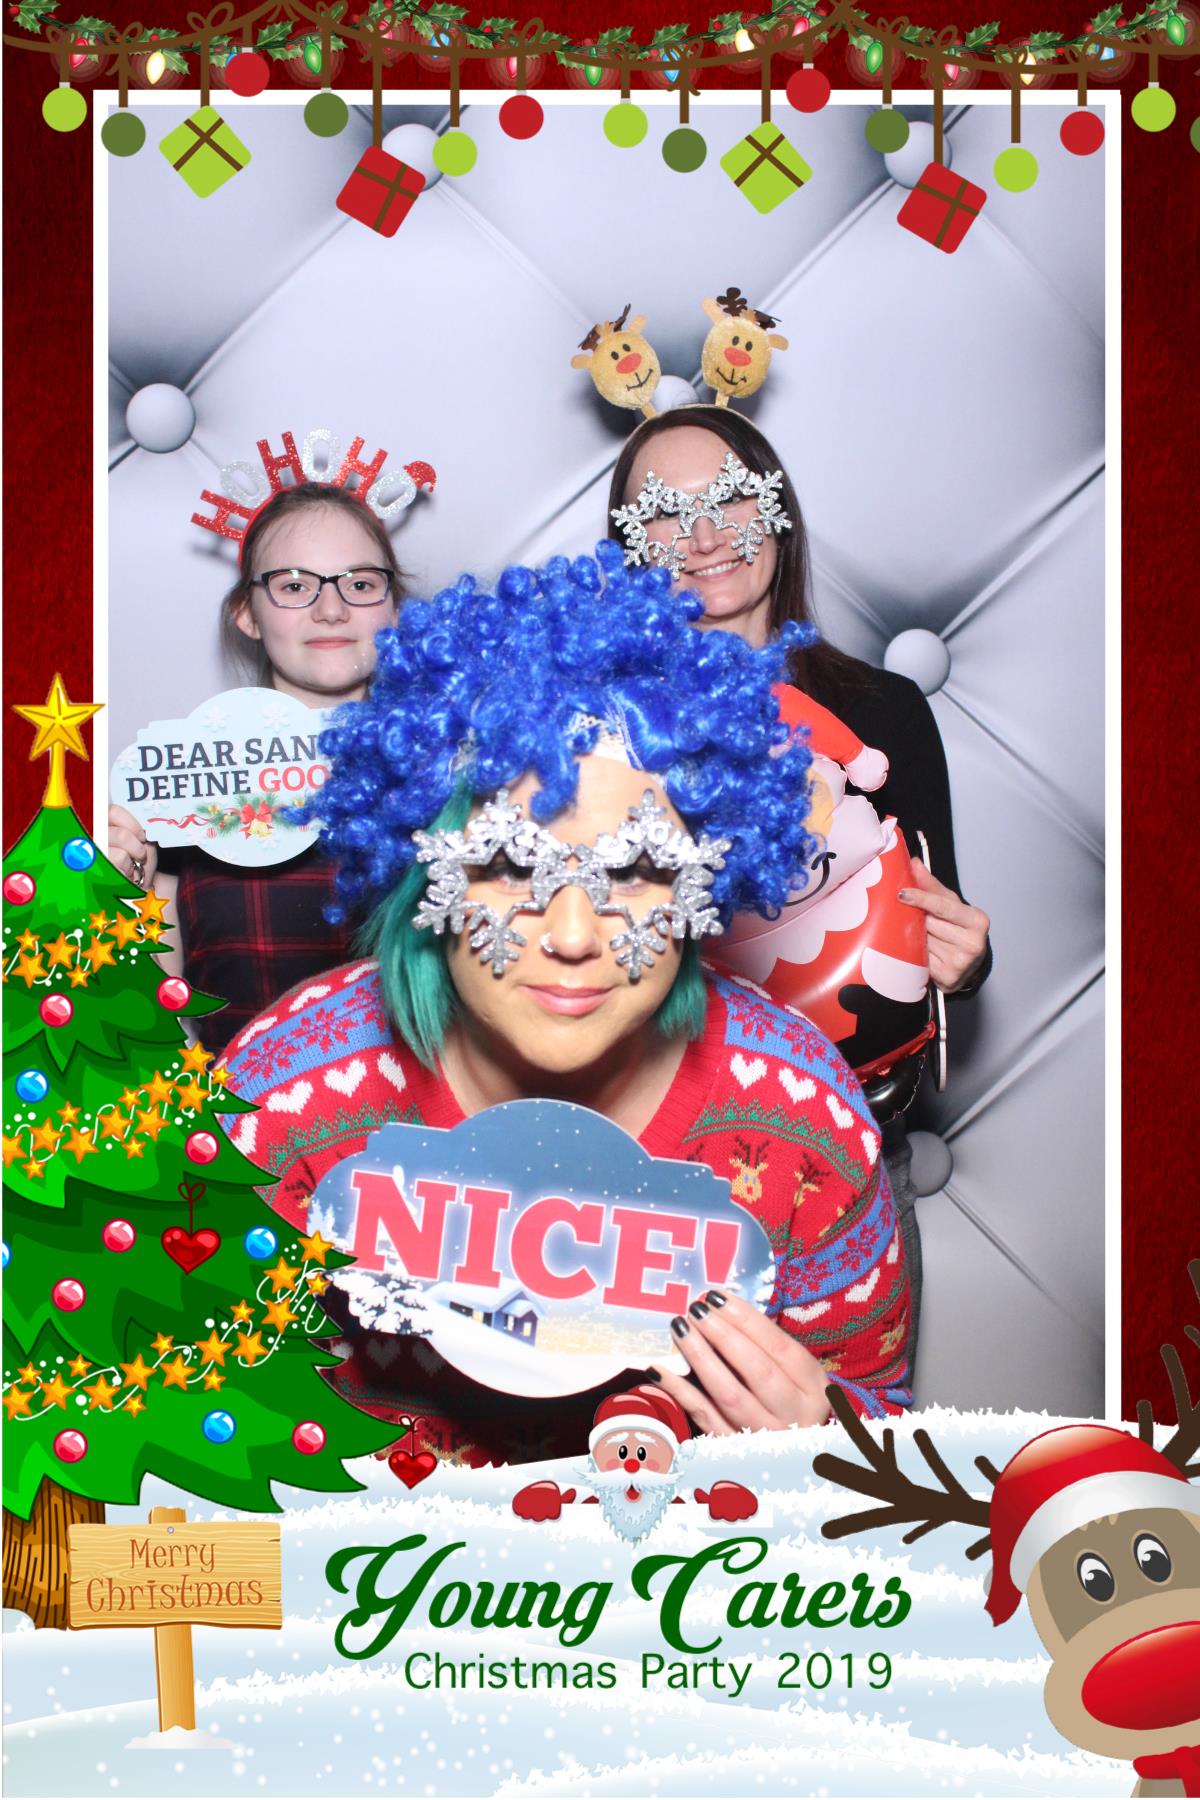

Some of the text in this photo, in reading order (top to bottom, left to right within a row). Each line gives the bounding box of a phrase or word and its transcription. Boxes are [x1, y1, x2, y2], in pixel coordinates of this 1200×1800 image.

[138, 735, 319, 773] DEAR SAN
[126, 764, 331, 802] DEFINE GOO
[351, 1170, 742, 1316] NICE!
